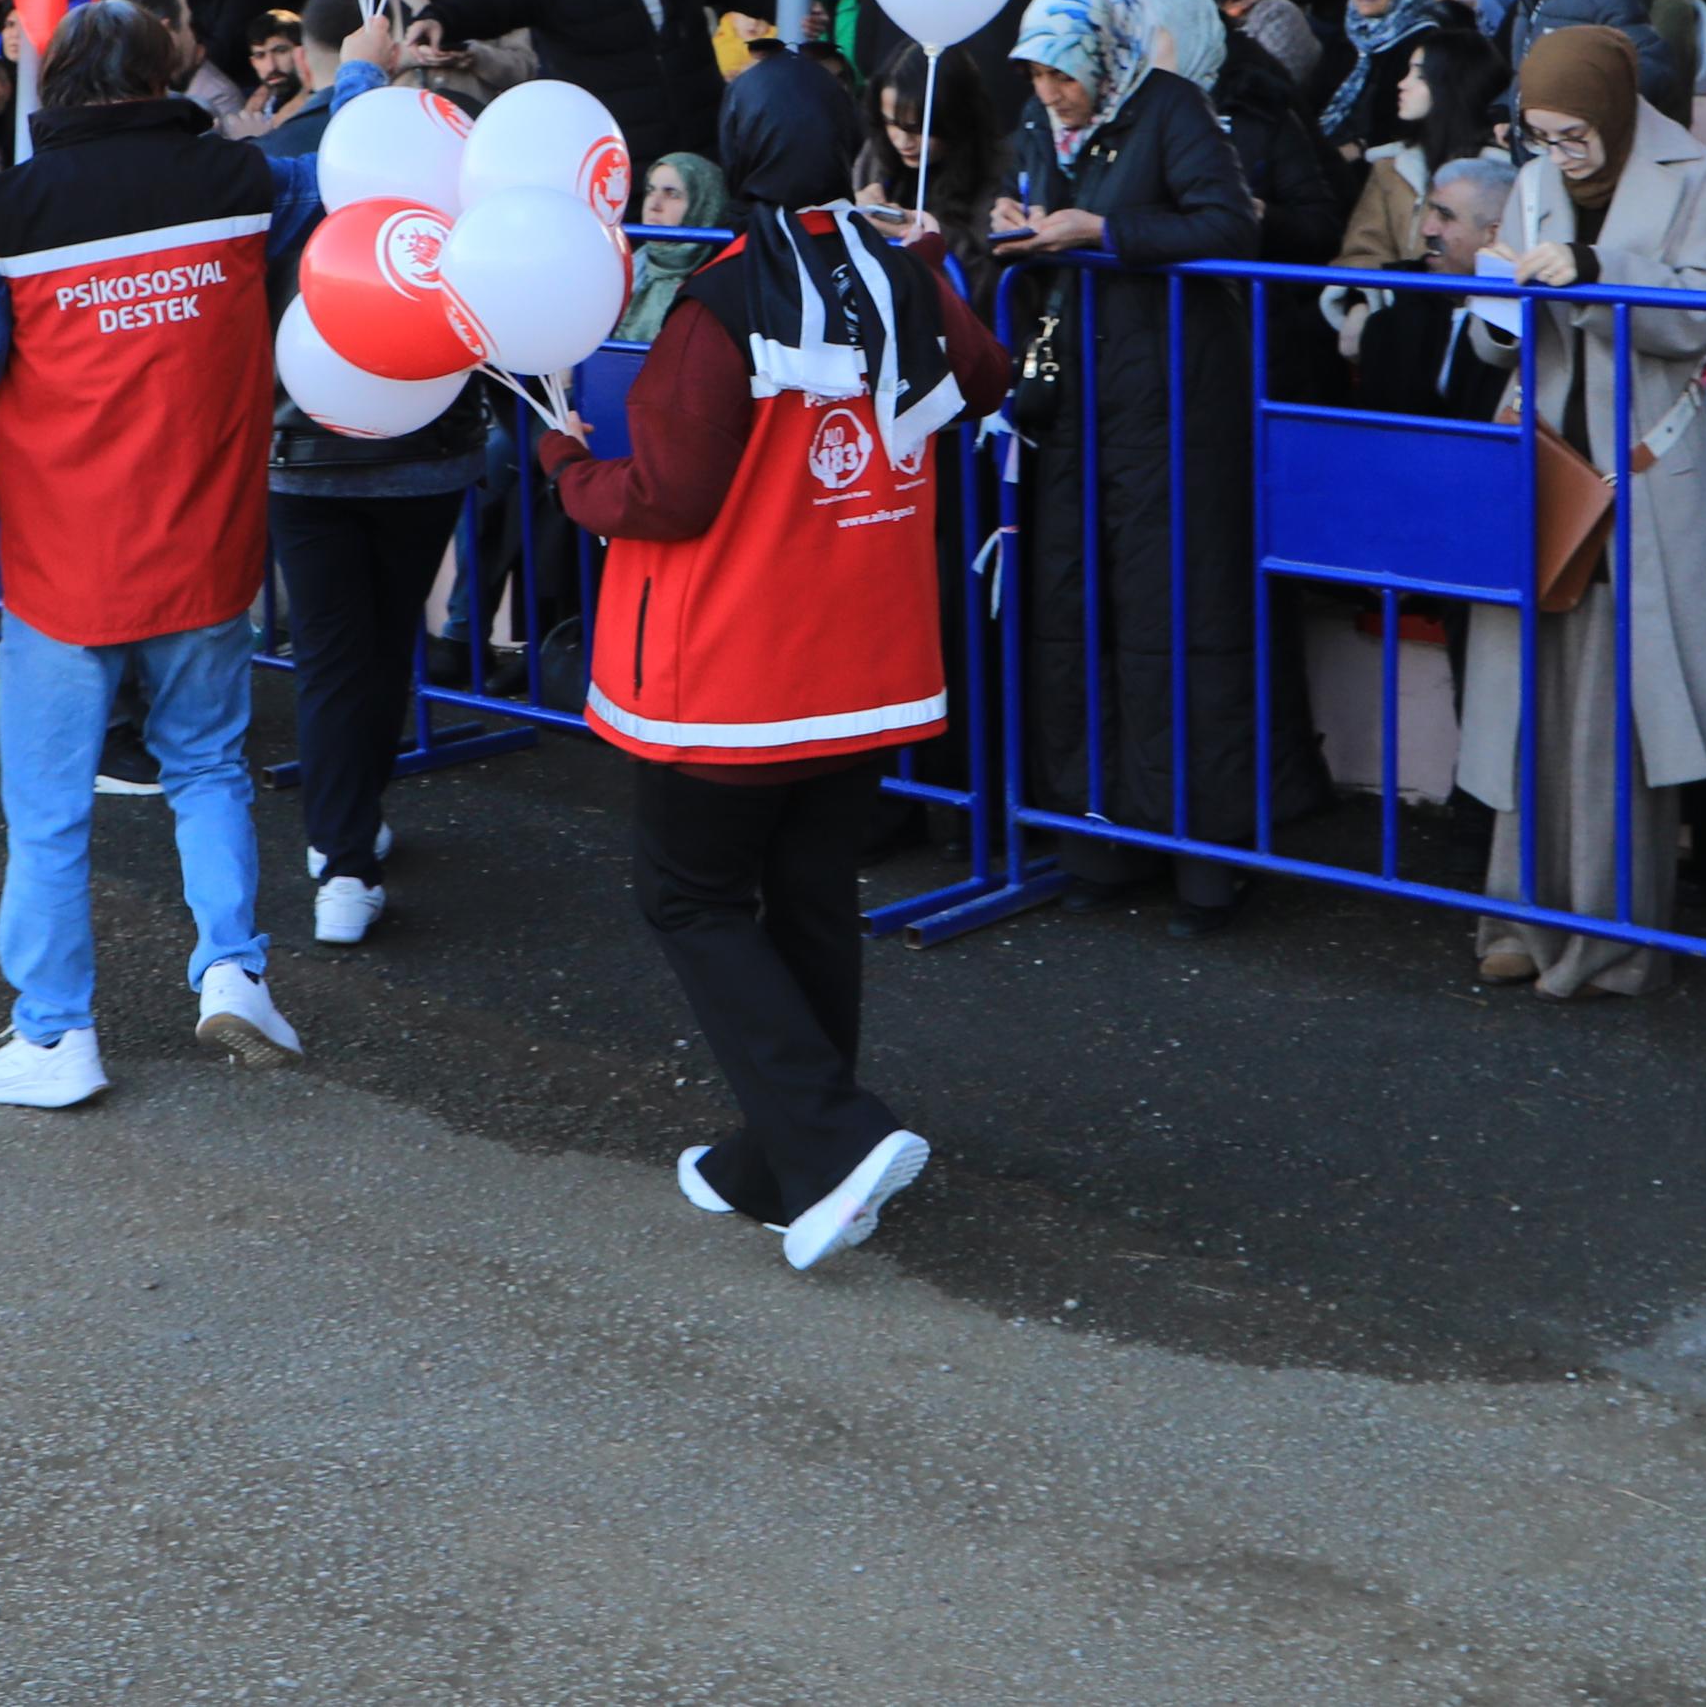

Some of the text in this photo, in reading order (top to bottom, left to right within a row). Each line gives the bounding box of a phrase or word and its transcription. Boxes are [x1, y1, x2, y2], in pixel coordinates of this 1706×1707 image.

[55, 260, 227, 311] PSİKOSOSYAL
[98, 294, 201, 334] DESTEK
[817, 442, 860, 474] 183
